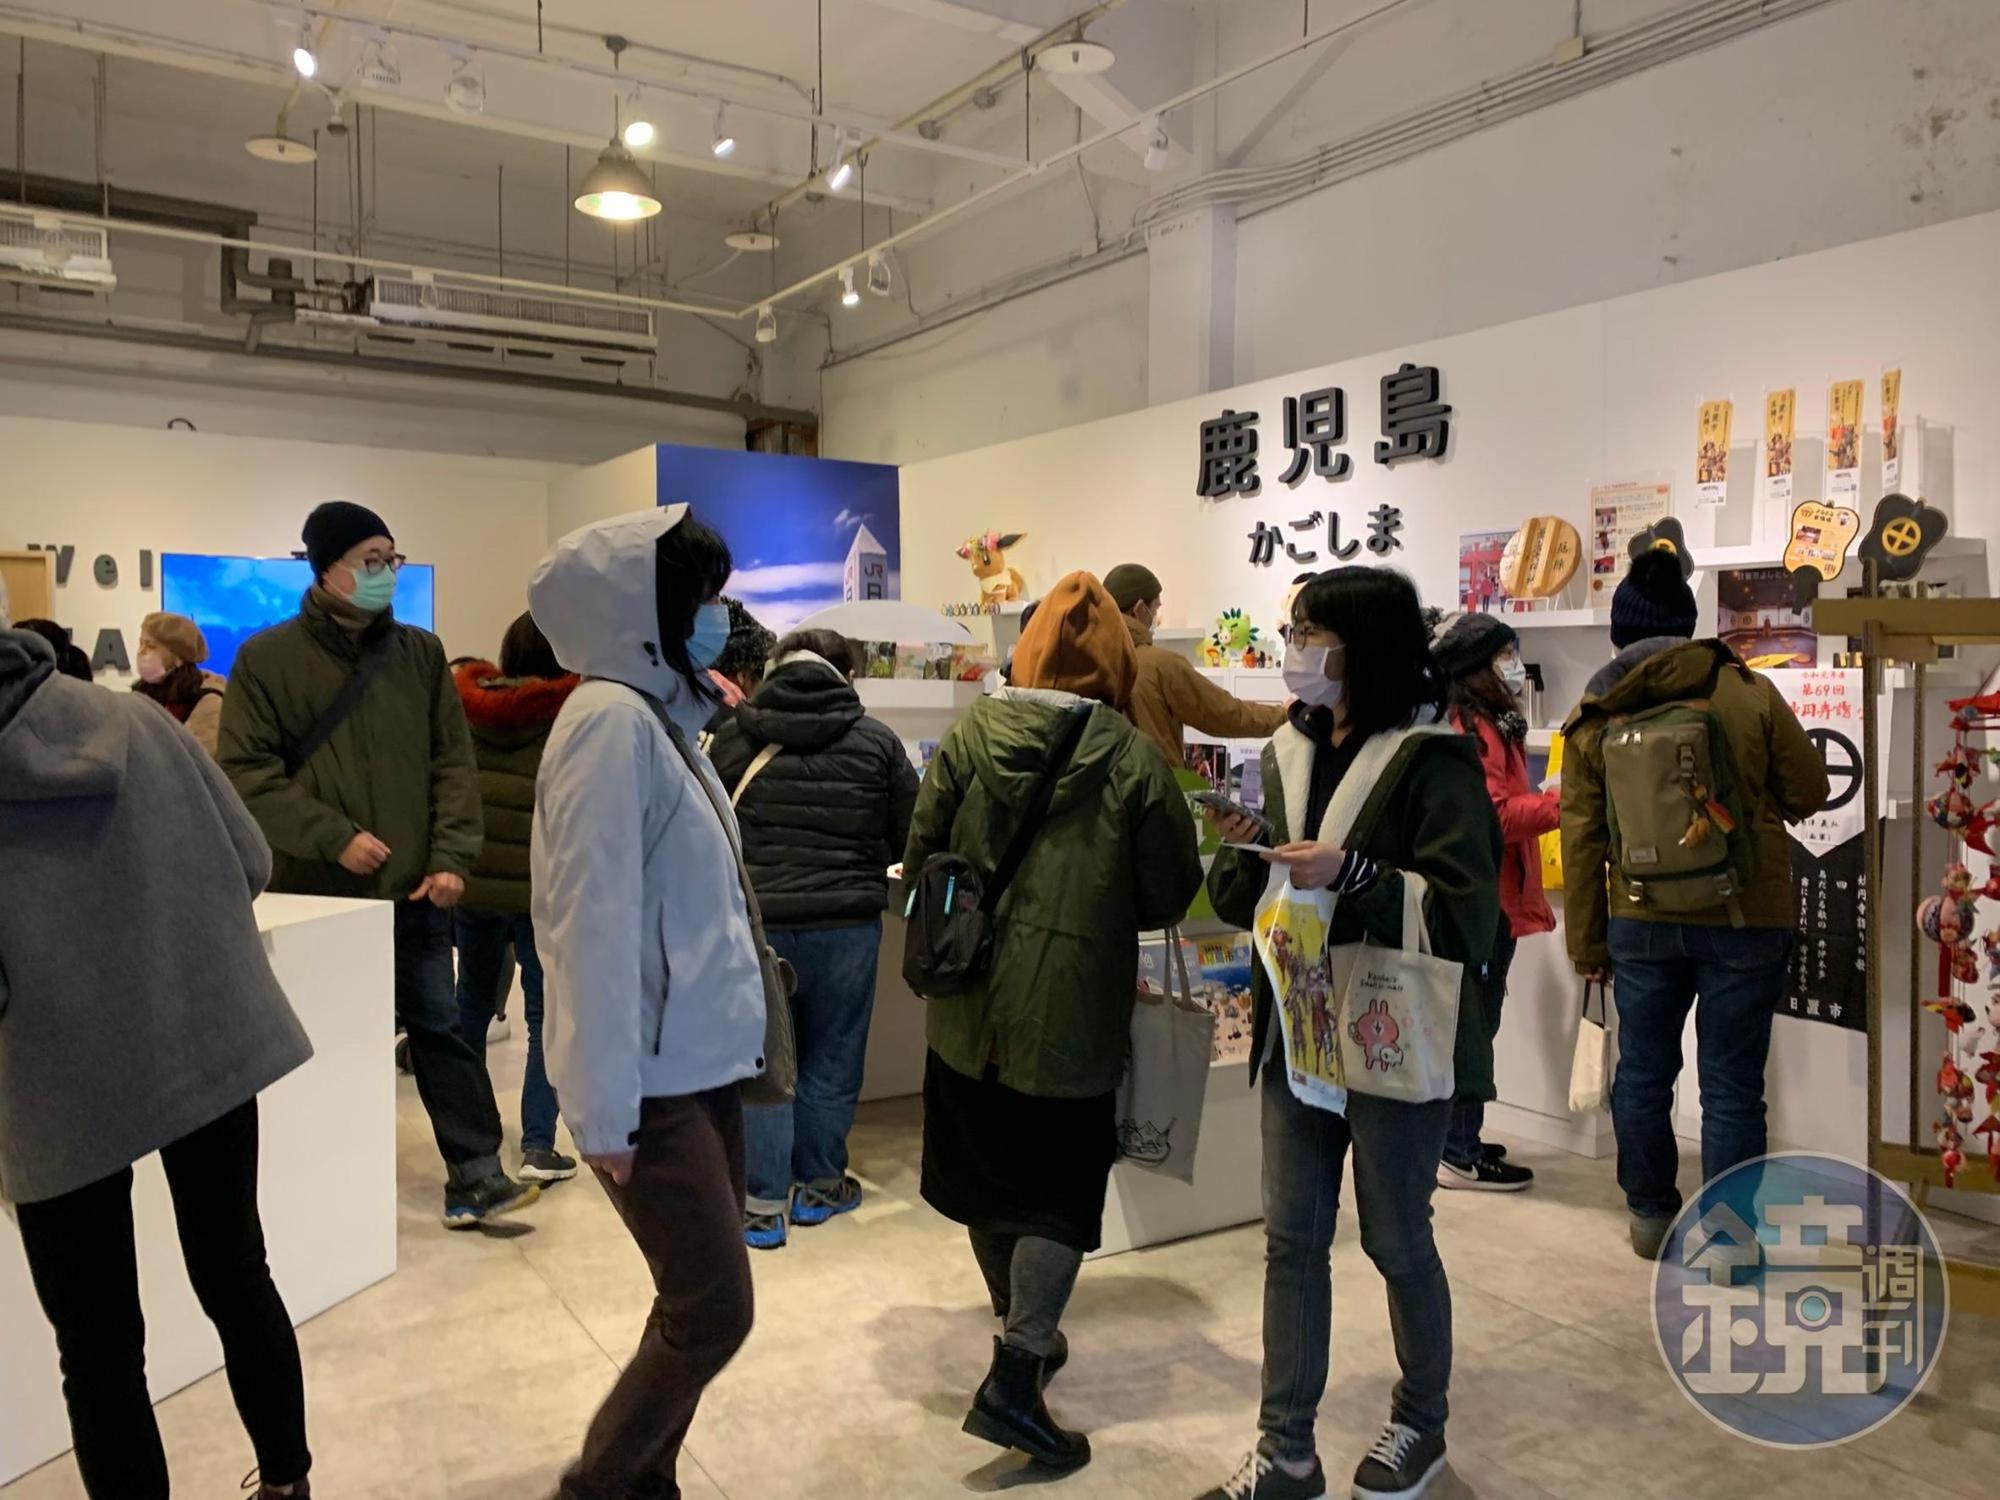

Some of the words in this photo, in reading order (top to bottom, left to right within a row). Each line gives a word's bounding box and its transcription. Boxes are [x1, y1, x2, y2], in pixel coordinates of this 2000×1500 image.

[1196, 363, 1452, 496] 鹿児島
[1247, 503, 1401, 564] かごしま
[1802, 682, 1845, 697] 第69回
[1789, 996, 1843, 1020] 日置市
